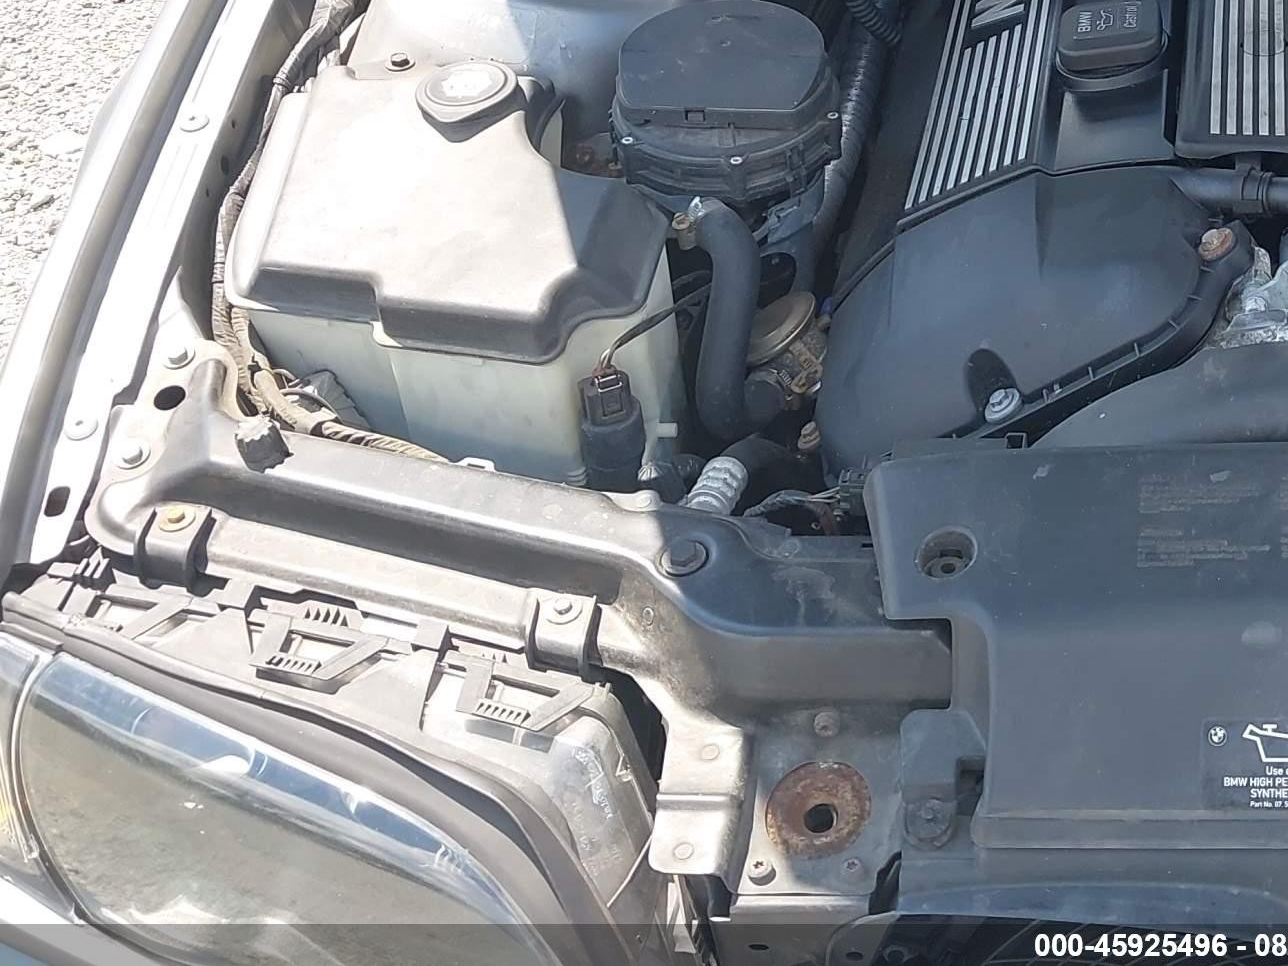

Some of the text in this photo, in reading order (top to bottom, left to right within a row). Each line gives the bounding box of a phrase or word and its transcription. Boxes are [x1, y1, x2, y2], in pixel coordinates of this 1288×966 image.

[1077, 11, 1093, 33] BMW
[1123, 0, 1139, 28] Castrol
[1265, 766, 1283, 776] Use
[1223, 777, 1248, 787] BMW
[1249, 777, 1273, 787] HIGH
